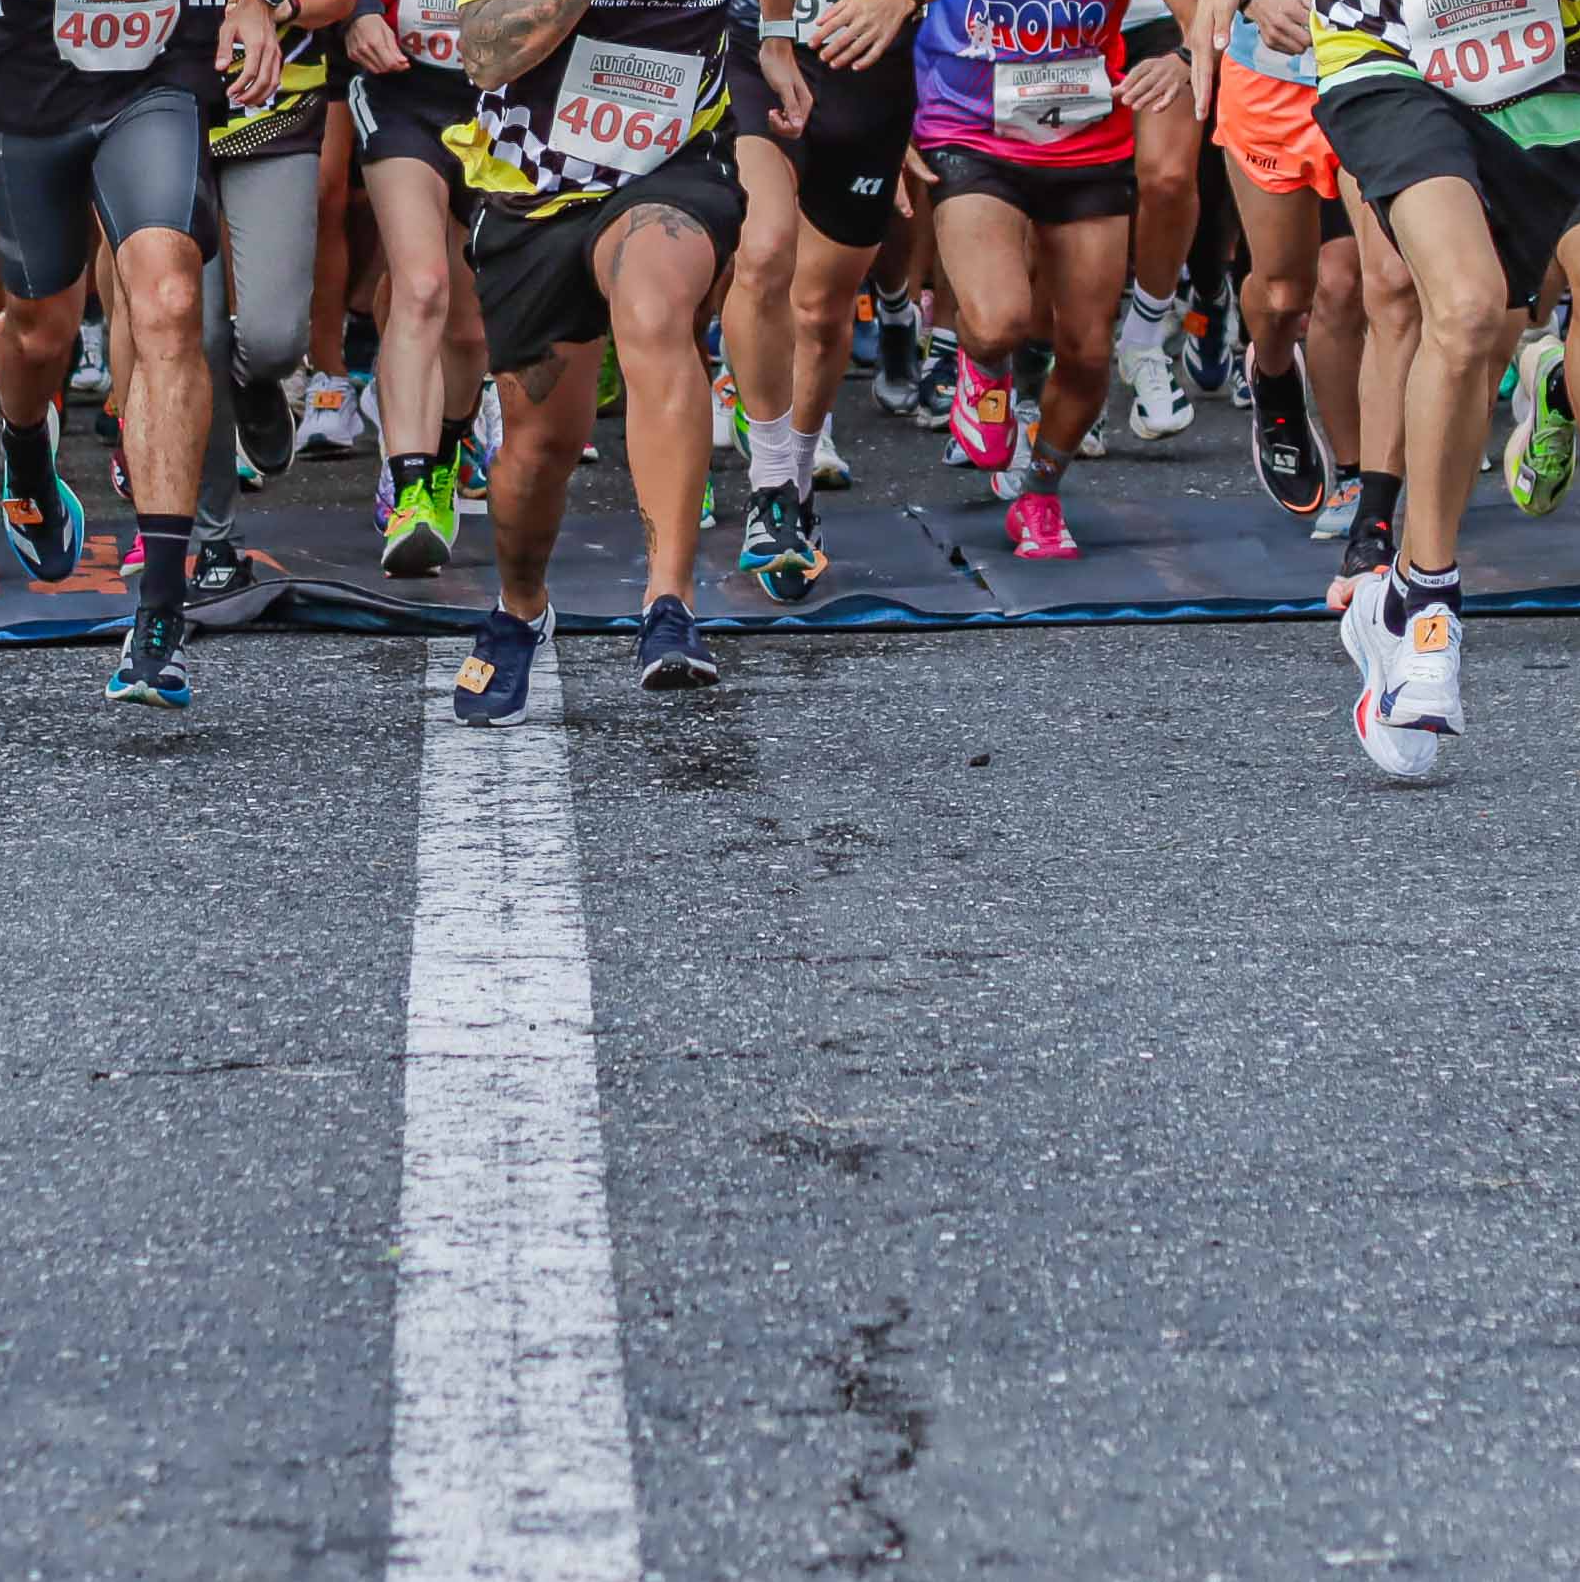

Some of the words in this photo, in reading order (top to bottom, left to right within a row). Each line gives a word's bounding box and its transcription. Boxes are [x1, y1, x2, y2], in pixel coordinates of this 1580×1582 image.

[57, 5, 176, 49] 4097
[1445, 6, 1489, 25] RUNNING
[1491, 0, 1518, 15] RACE
[1424, 20, 1557, 89] 4019
[590, 53, 685, 86] AUTÓDROMO
[602, 75, 643, 91] RUNNING
[645, 82, 668, 97] RACE
[557, 96, 683, 155] 4064
[1037, 106, 1065, 129] 4
[851, 177, 884, 195] K1
